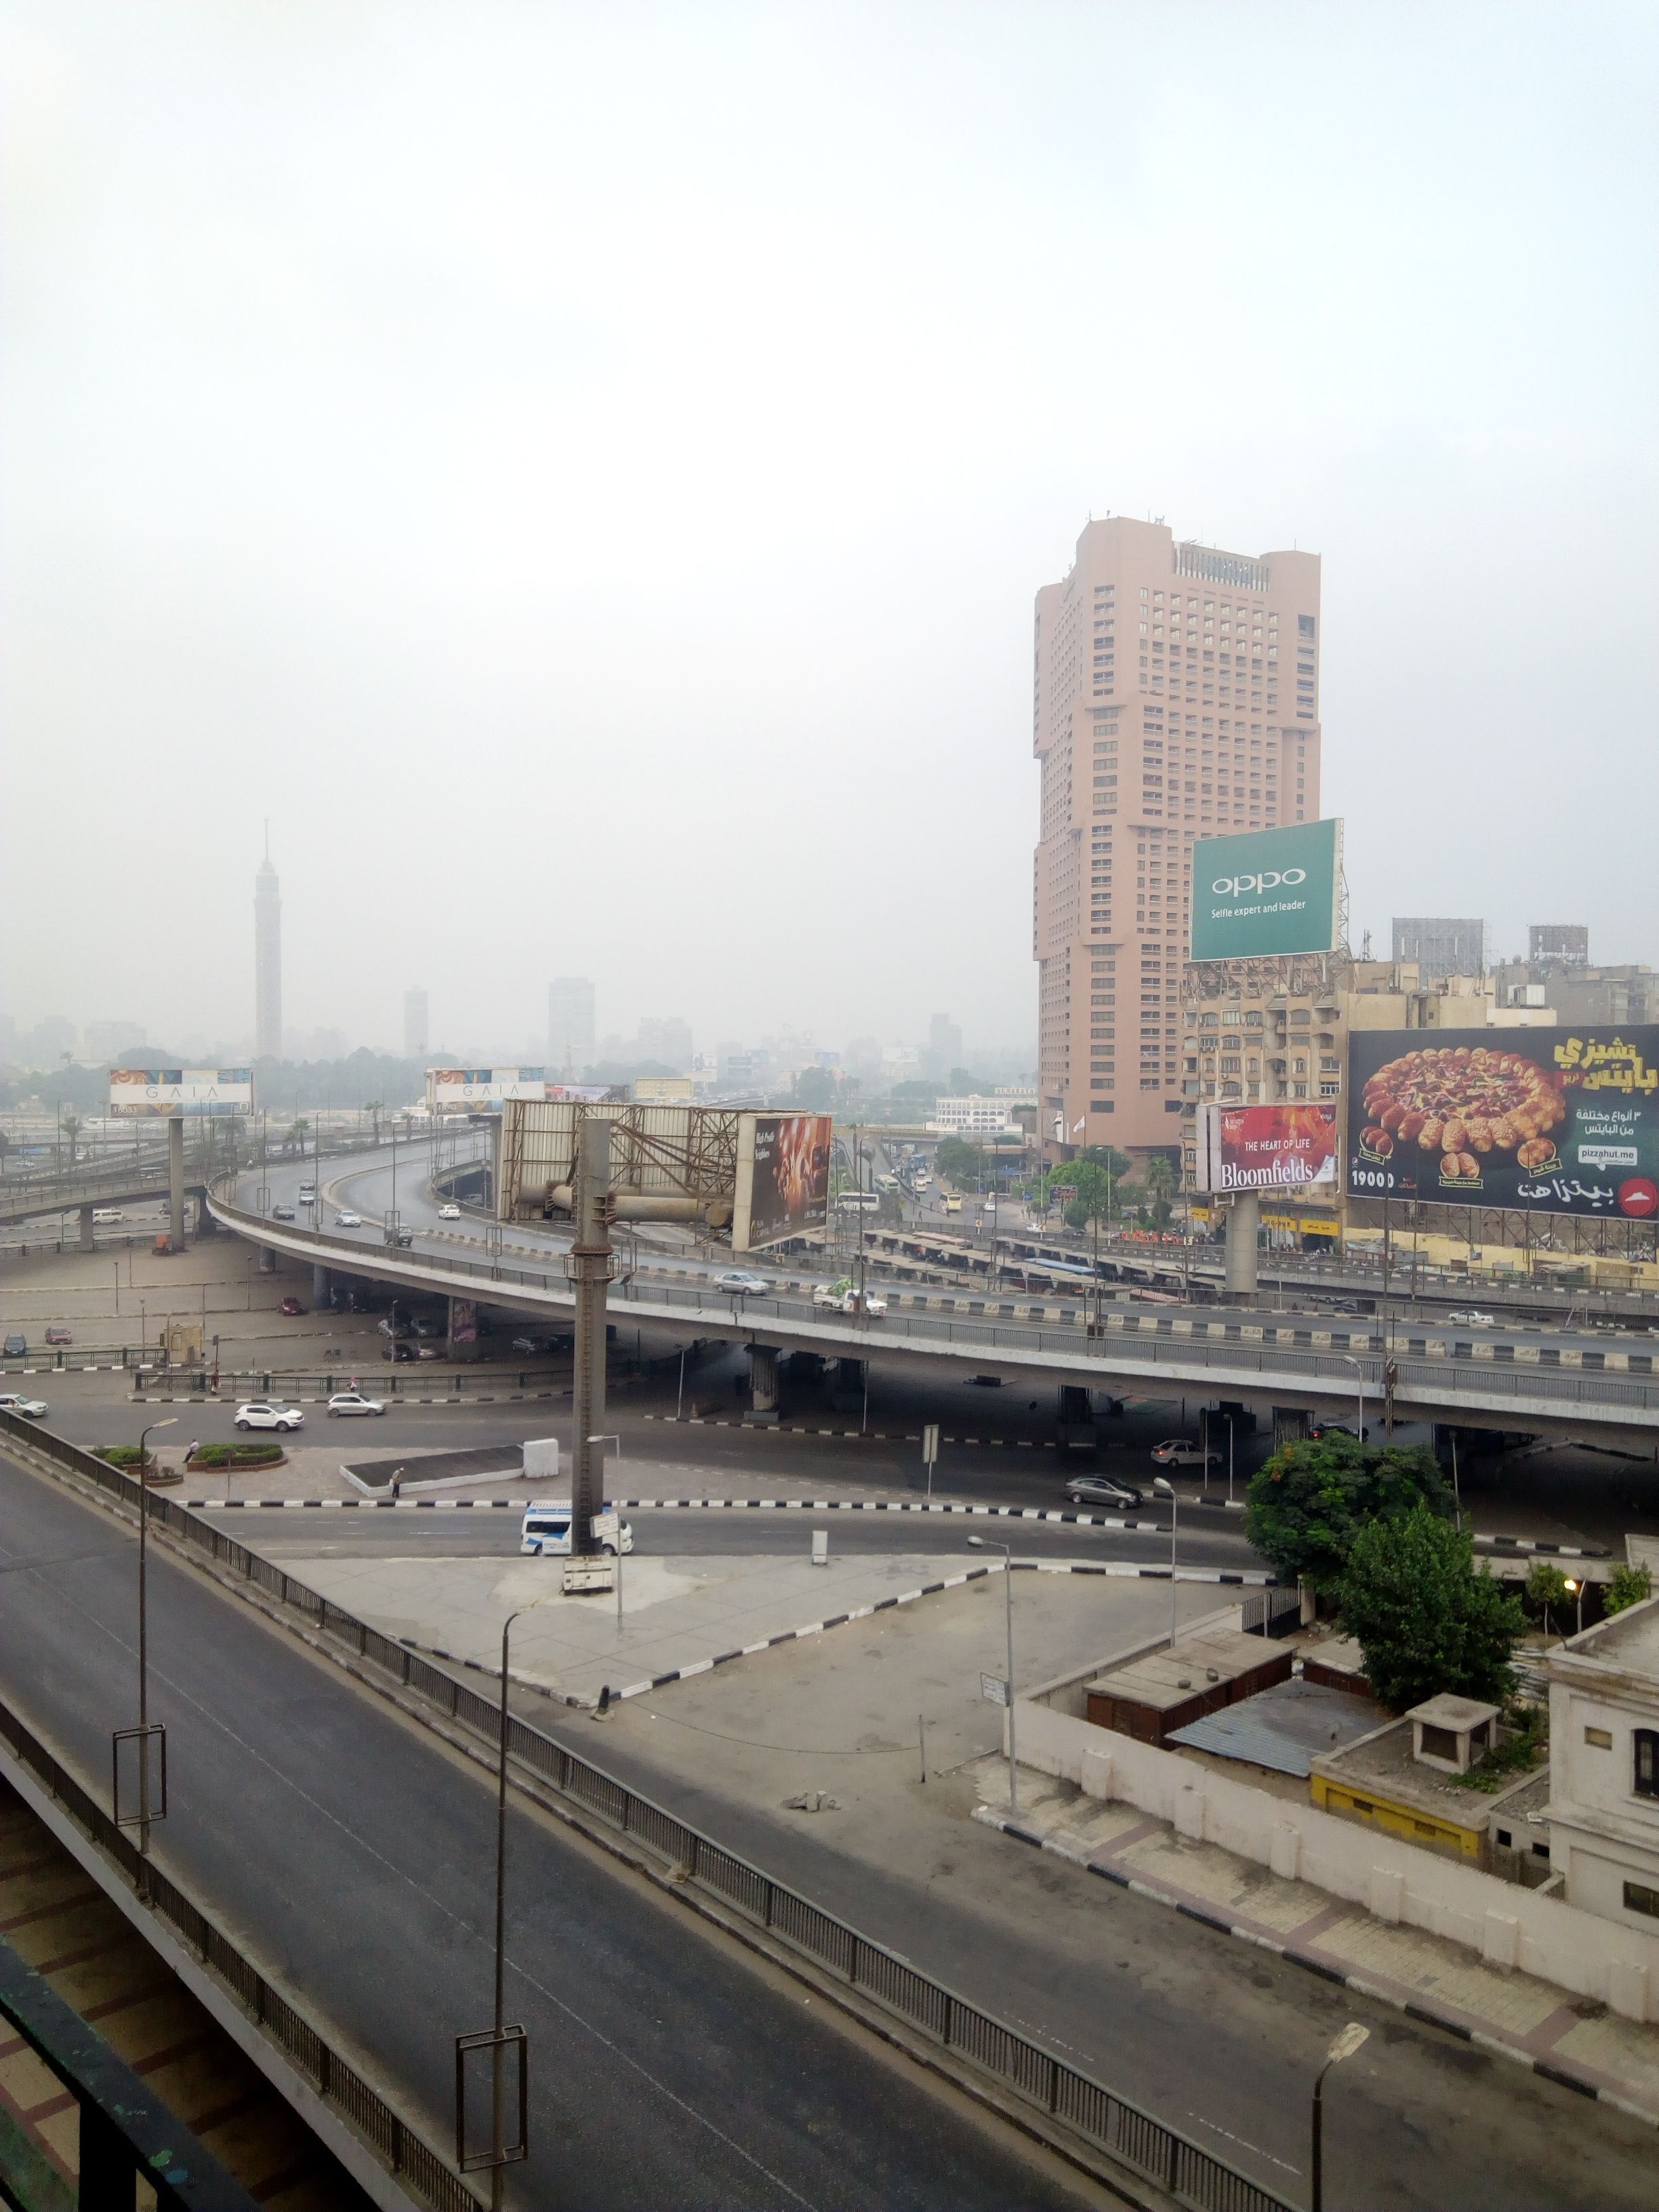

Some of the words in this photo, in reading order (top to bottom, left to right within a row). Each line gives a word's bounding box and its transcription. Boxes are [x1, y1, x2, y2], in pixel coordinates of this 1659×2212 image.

[1211, 907, 1233, 919] Selfie
[1234, 905, 1261, 918] expert
[1263, 903, 1278, 914] and
[1279, 899, 1306, 912] leader
[1554, 1036, 1637, 1069] تشيزي
[146, 1086, 218, 1099] GAIA
[463, 1084, 520, 1097] GAIA
[1576, 1109, 1610, 1122] مختلفة
[1619, 1124, 1634, 1136] من
[1245, 1141, 1258, 1151] THE
[1260, 1140, 1281, 1151] HEART
[1283, 1139, 1294, 1150] OF
[1295, 1139, 1310, 1149] LIFE
[1582, 1148, 1635, 1159] pizzahut.me
[1221, 1158, 1313, 1187] Bloomfields
[1352, 1170, 1394, 1189] 19000
[1552, 1179, 1614, 1208] بيتزا
